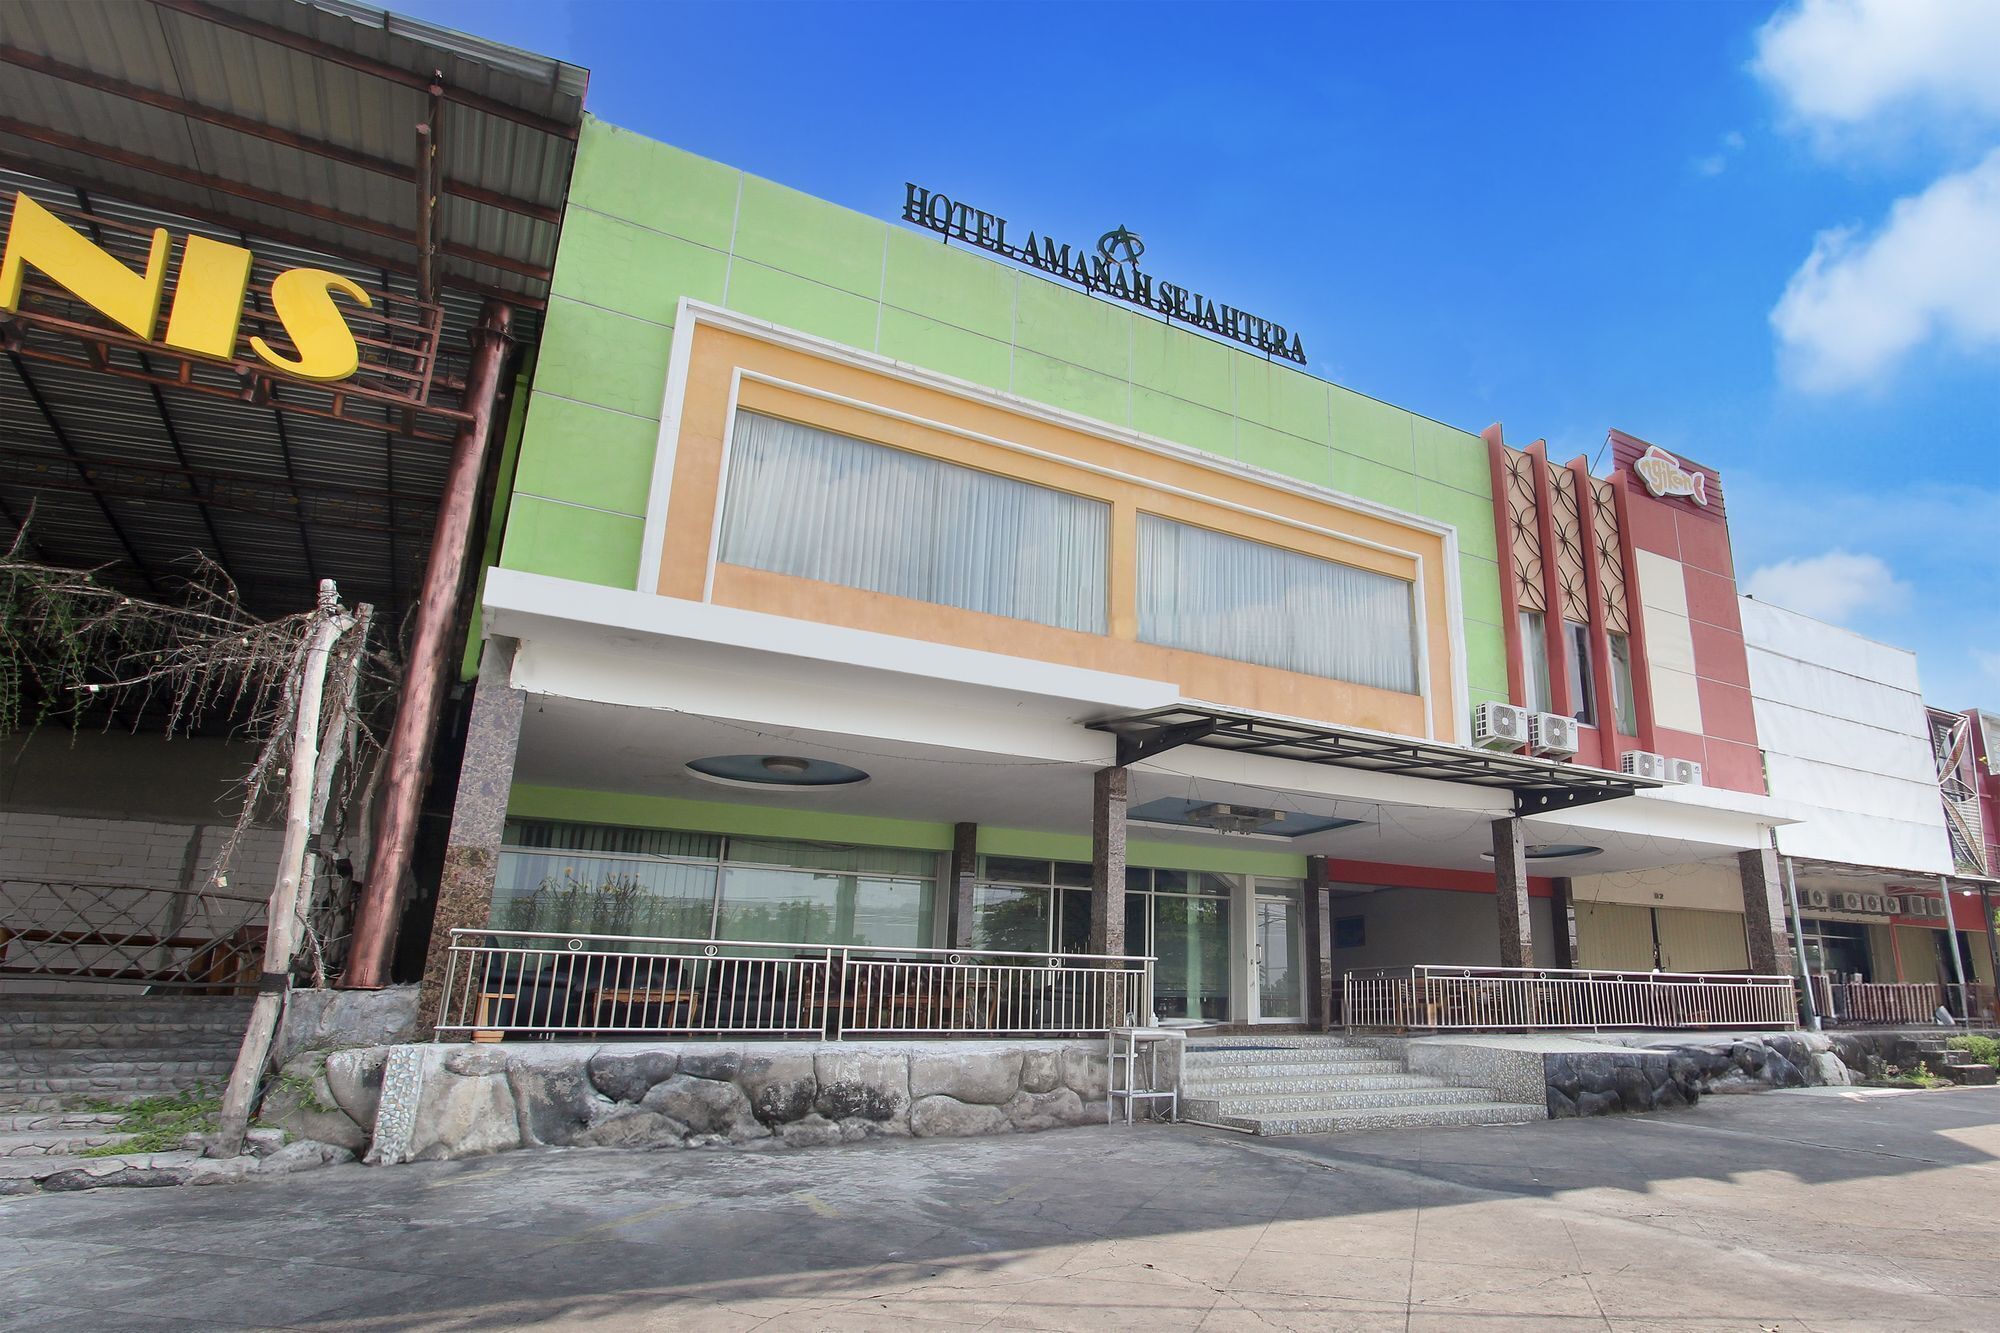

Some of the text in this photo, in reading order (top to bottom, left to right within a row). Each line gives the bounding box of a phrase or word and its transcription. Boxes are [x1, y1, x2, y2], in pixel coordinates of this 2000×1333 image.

[902, 182, 1307, 366] HOTEL AMANAH SEJAHTERA
